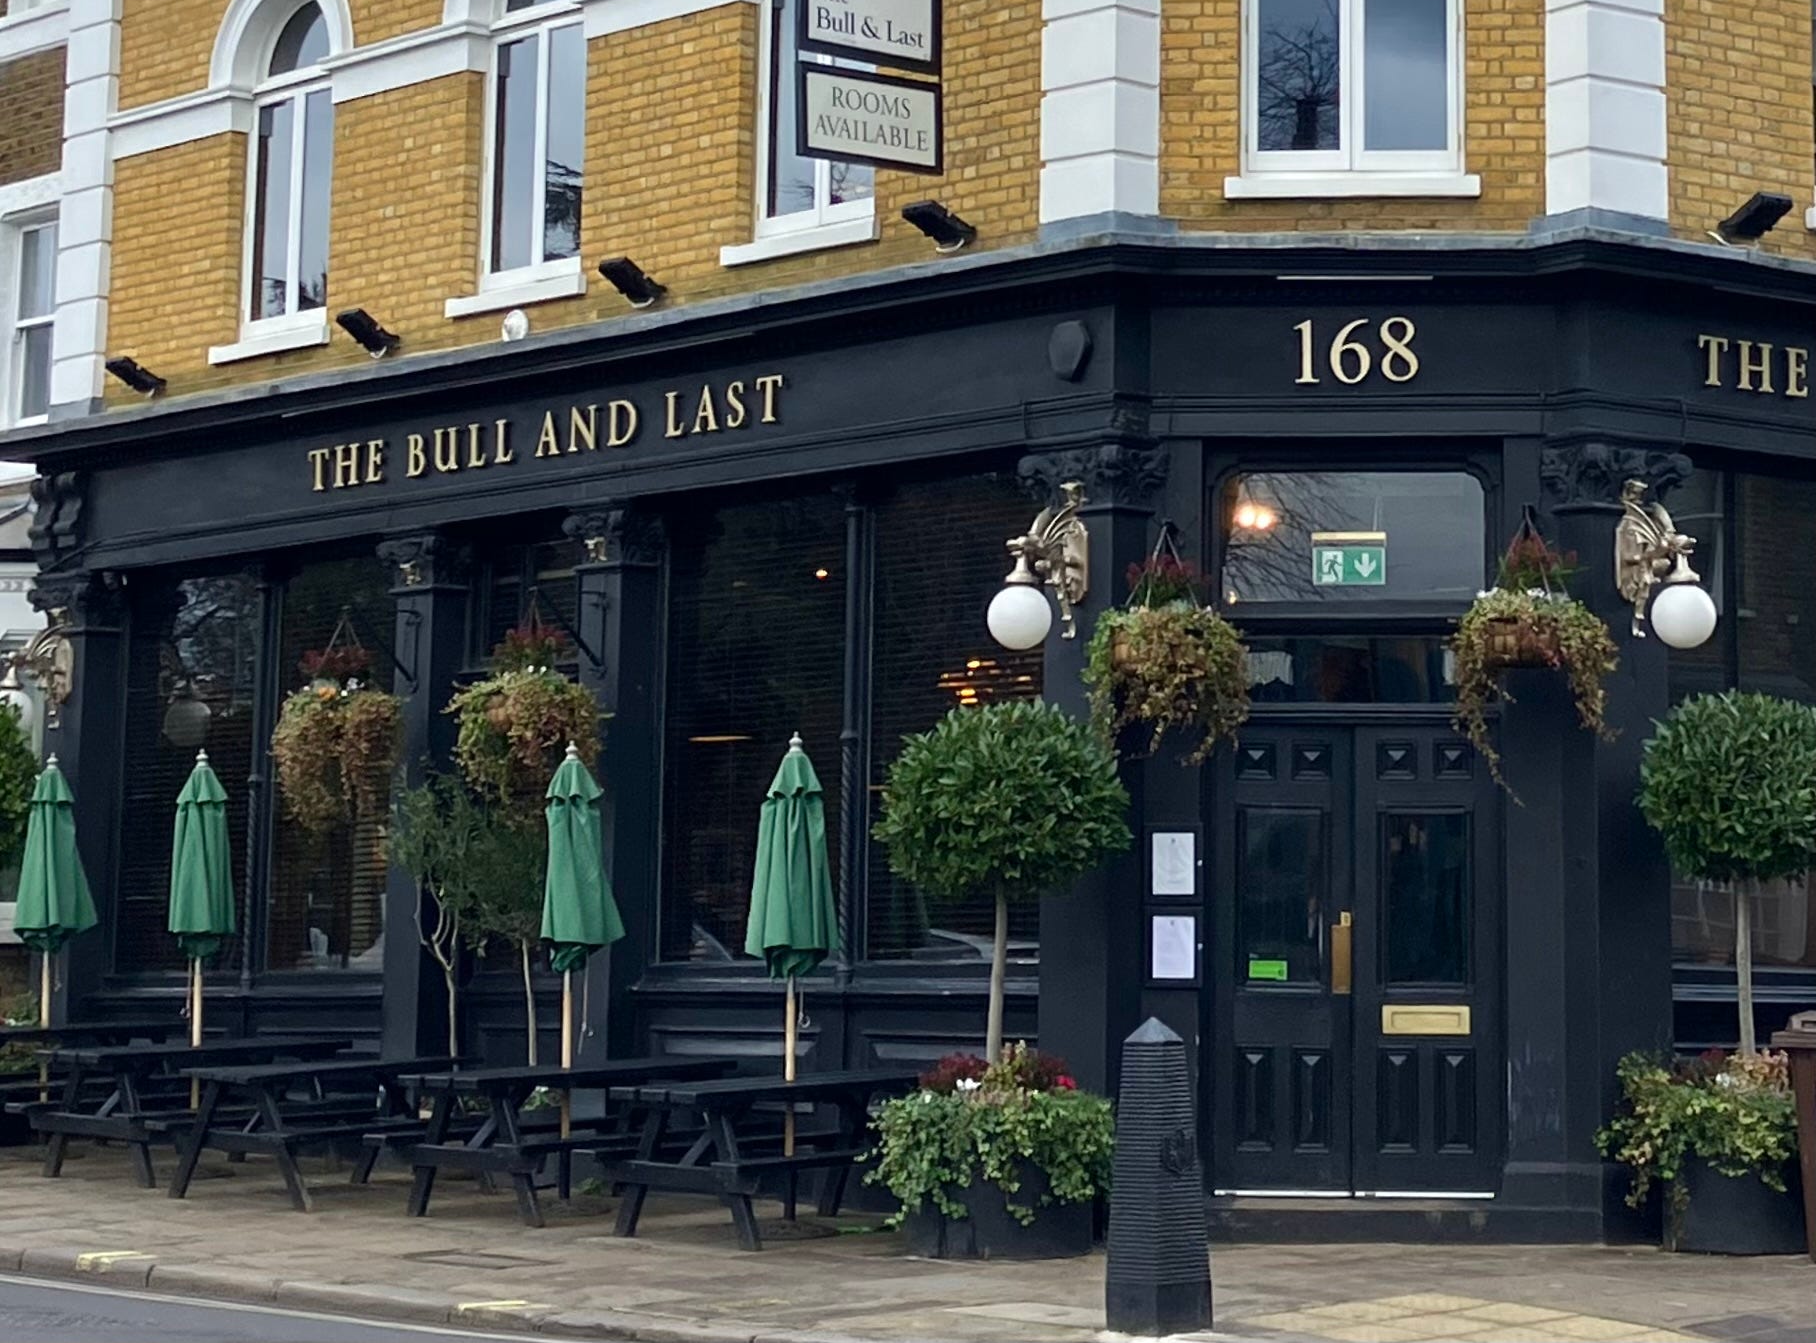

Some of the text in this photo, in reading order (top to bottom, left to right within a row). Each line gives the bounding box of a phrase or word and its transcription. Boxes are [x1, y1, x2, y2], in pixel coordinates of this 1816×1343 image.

[816, 6, 925, 49] Bull & Last
[832, 86, 912, 120] ROOMS
[814, 114, 930, 153] AVAILABLE
[1293, 316, 1420, 384] 168
[1698, 334, 1809, 398] THE
[308, 374, 783, 491] THE BULL AND LAST
